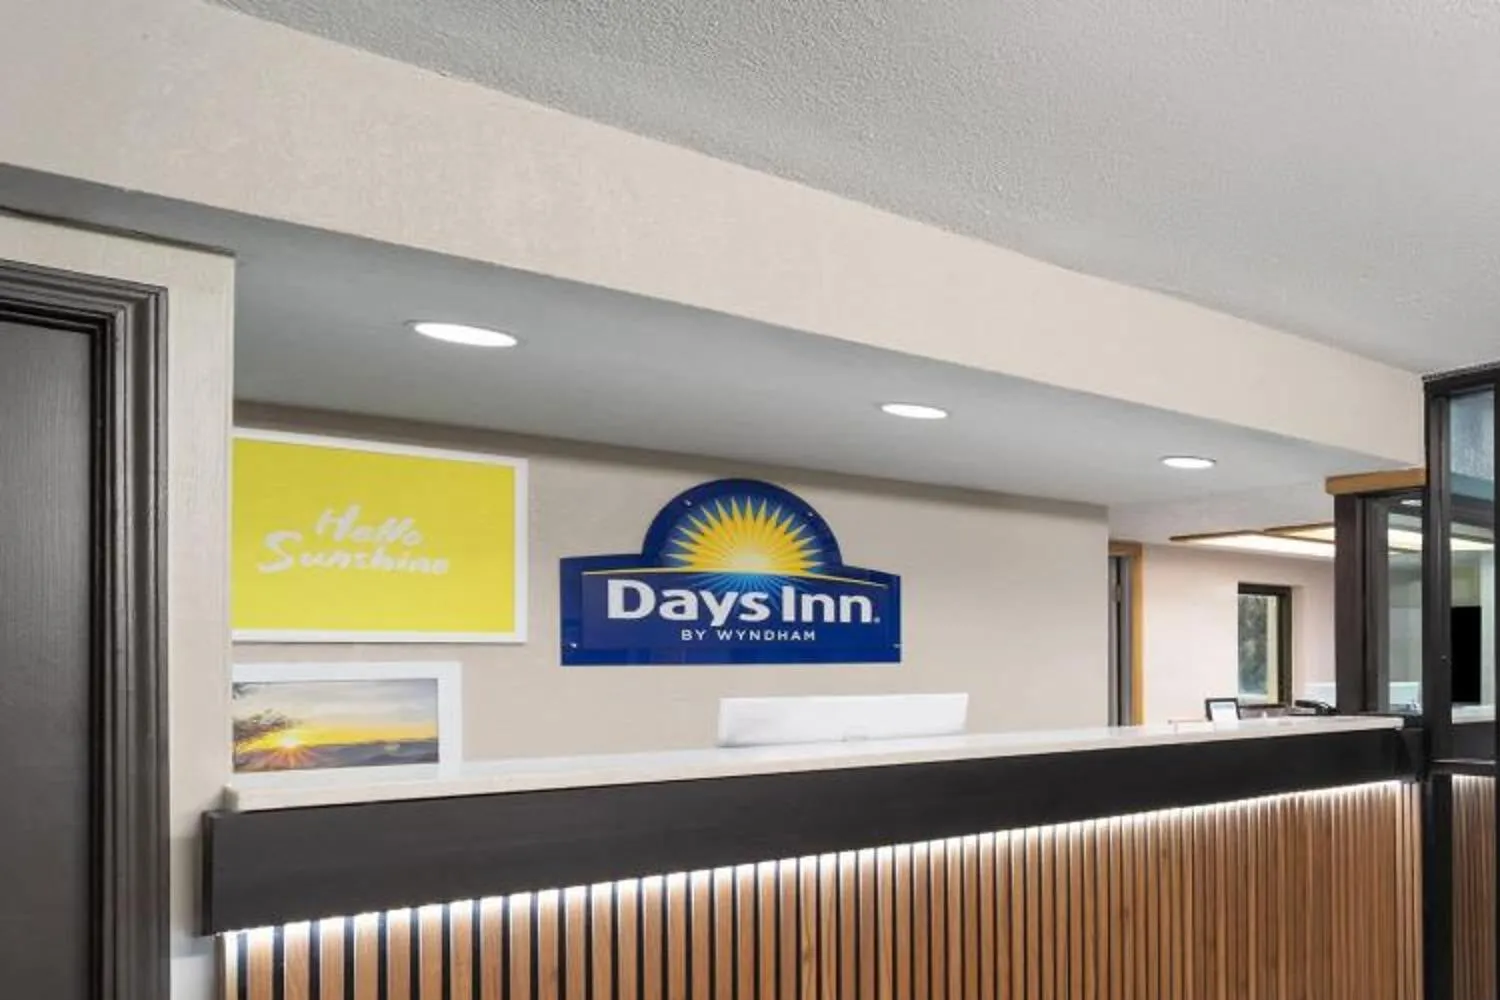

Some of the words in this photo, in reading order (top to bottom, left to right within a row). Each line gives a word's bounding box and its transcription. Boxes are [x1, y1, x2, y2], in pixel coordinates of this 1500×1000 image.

[313, 503, 422, 546] Hello
[257, 529, 449, 575] Sunshine
[607, 578, 772, 627] Days
[781, 585, 874, 623] Inn
[681, 629, 706, 641] BY
[717, 630, 816, 641] WYNDHAM
